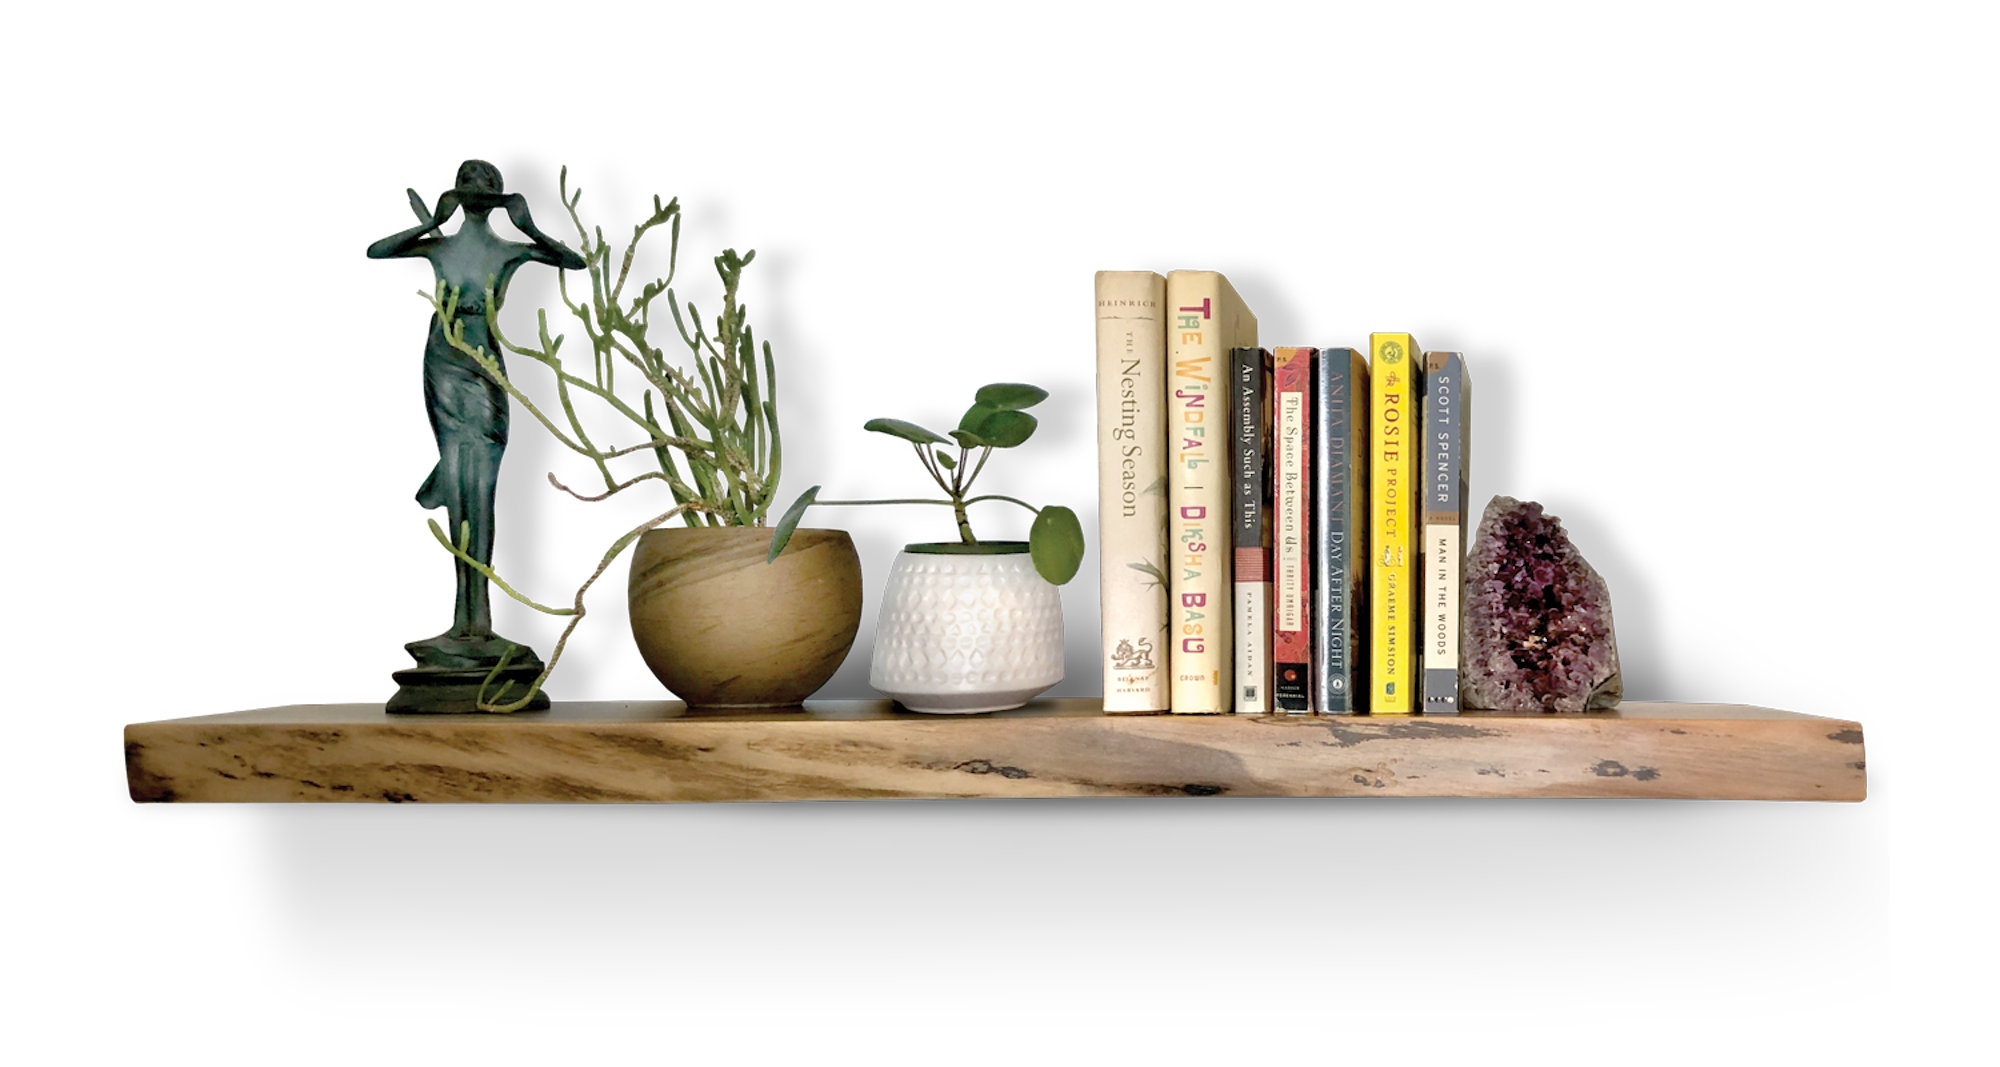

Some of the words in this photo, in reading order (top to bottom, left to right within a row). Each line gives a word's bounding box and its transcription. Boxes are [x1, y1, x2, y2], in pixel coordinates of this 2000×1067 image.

[1126, 331, 1134, 353] THE
[1242, 365, 1254, 382] An
[1113, 358, 1141, 440] Nesting
[1239, 387, 1254, 444] Assembly
[1284, 397, 1298, 422] The
[1329, 371, 1344, 426] ANITA
[1437, 376, 1451, 424] SCOTT
[1280, 427, 1298, 468] Space
[1383, 393, 1400, 462] ROSIE
[1122, 445, 1143, 518] Season
[1243, 449, 1256, 480] Such
[1329, 436, 1344, 523] DIAMANT
[1437, 433, 1451, 503] SPENCER
[1243, 483, 1253, 495] as
[1284, 472, 1299, 532] Between
[1385, 468, 1397, 537] PROJECT
[1243, 501, 1256, 529] This
[1180, 506, 1206, 581] DIKSHA
[1284, 536, 1299, 553] Us
[1330, 531, 1344, 560] DAY
[1437, 538, 1447, 563] MAN
[1285, 564, 1295, 592] THRITY
[1331, 566, 1344, 612] AFTER
[1387, 573, 1397, 621] GRAEME
[1437, 568, 1447, 582] IN
[1437, 586, 1447, 608] THE
[1181, 593, 1206, 654] BASU
[1246, 592, 1254, 637] PAMELA
[1285, 595, 1295, 626] UMRIGAR
[1331, 618, 1344, 668] NIGHT
[1387, 625, 1397, 675] SIMSION
[1437, 614, 1447, 656] WOODS
[1246, 643, 1254, 676] AIDAN
